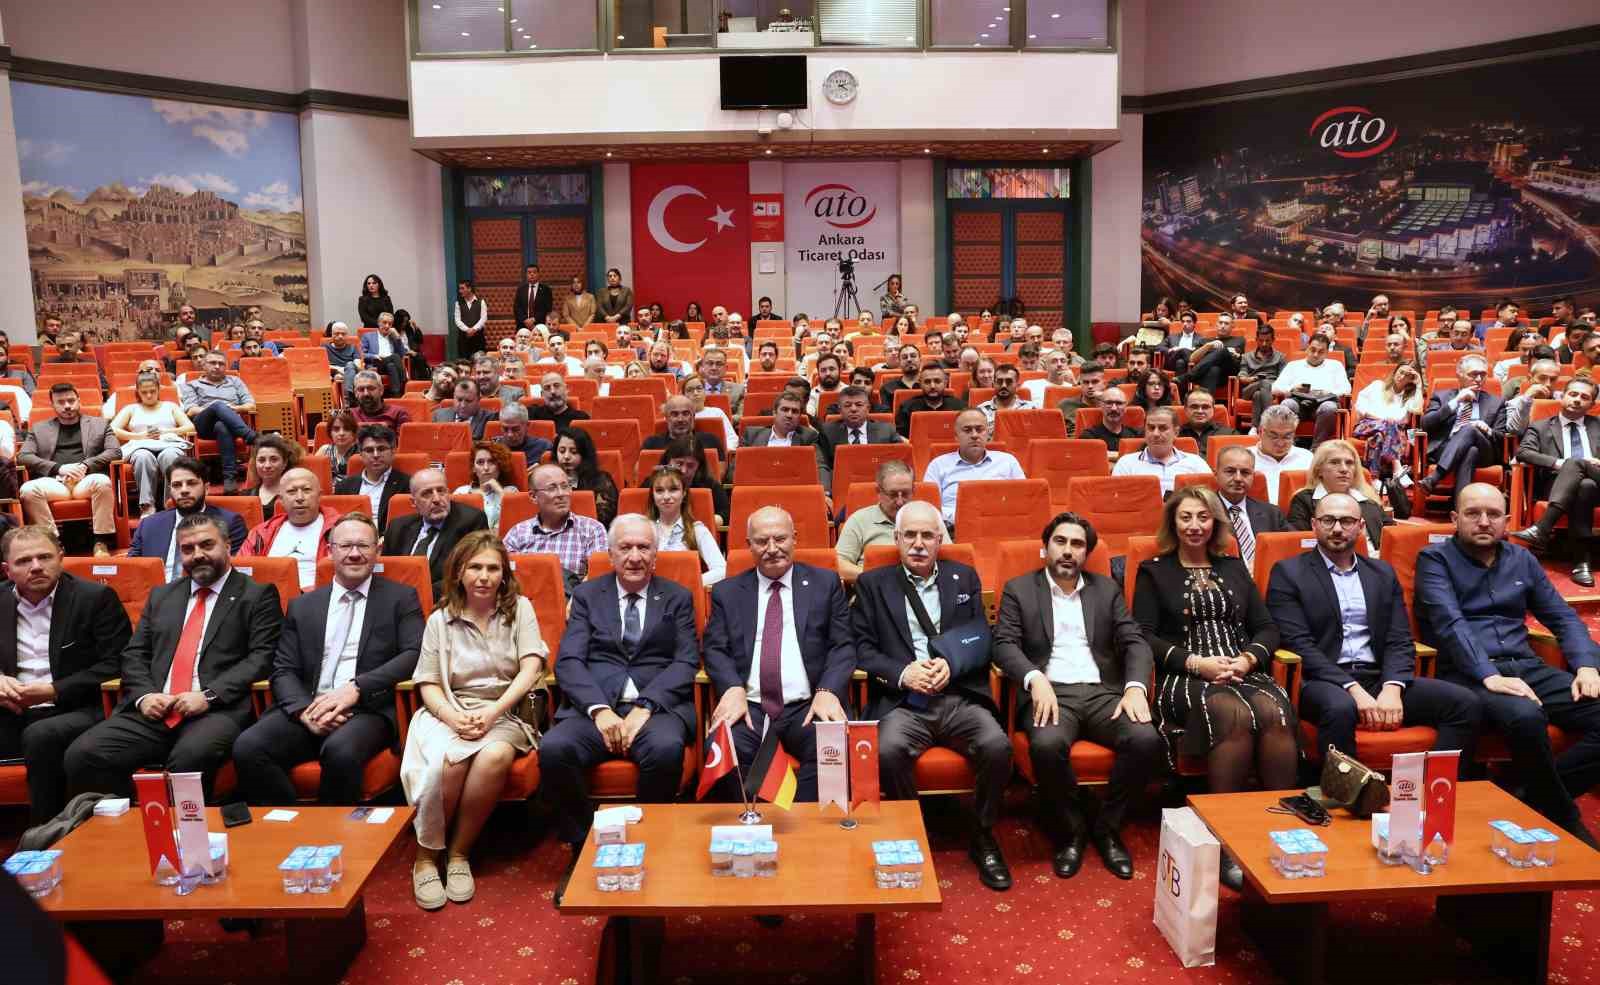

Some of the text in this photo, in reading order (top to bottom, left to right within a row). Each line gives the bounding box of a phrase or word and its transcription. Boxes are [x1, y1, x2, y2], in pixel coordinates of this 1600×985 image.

[1320, 113, 1386, 148] ato
[814, 191, 867, 218] ato
[818, 233, 865, 246] Ankara
[798, 249, 842, 262] Ticaret
